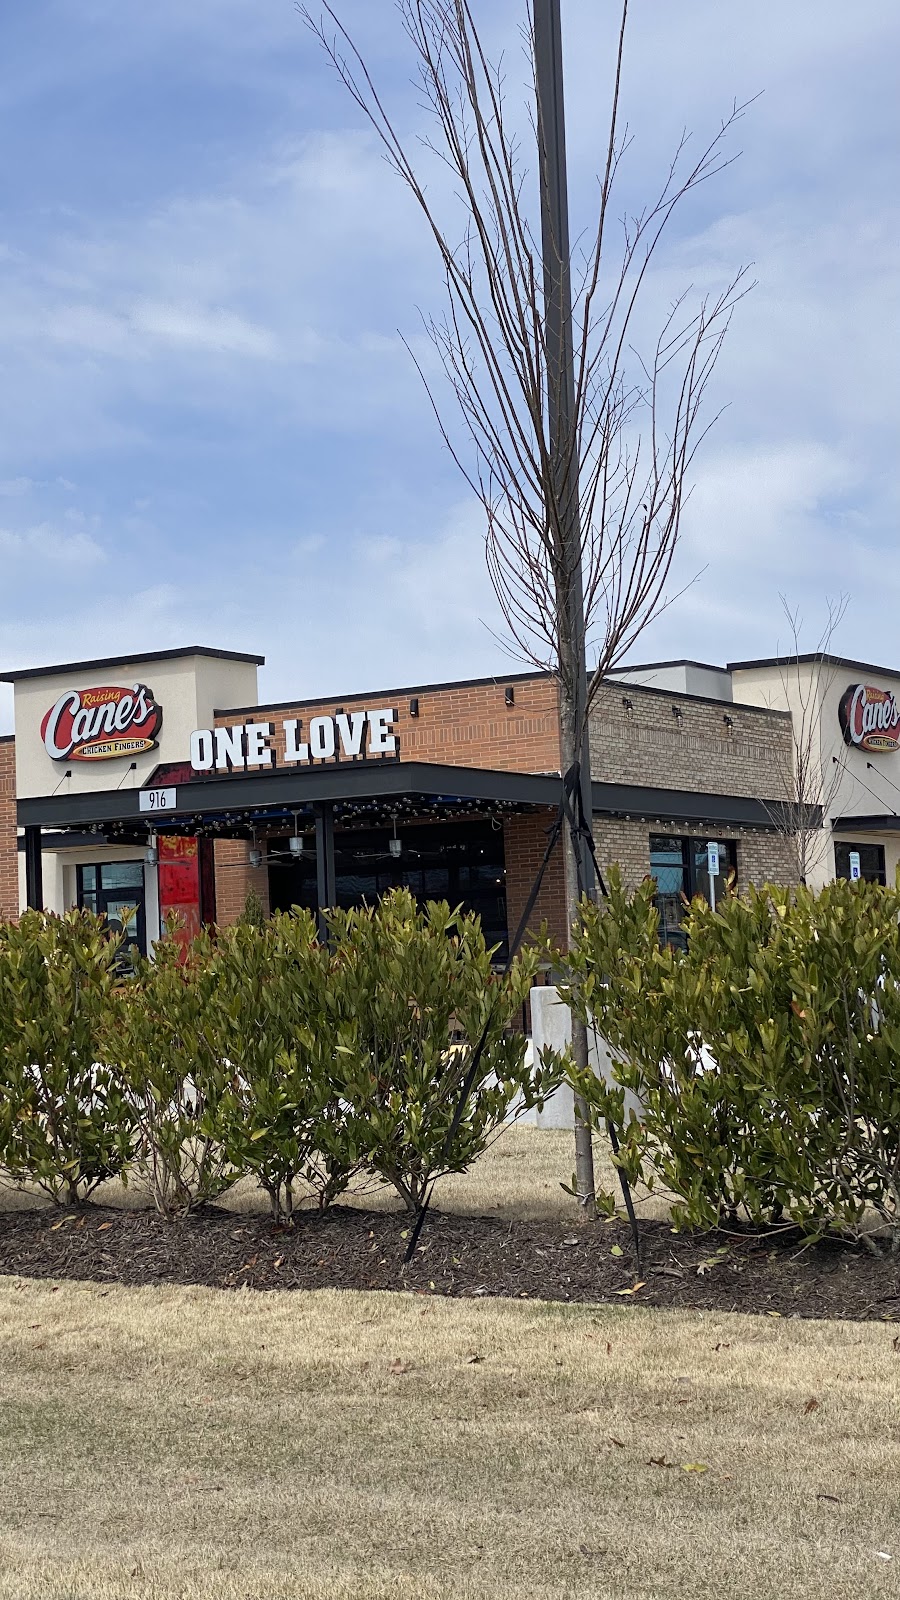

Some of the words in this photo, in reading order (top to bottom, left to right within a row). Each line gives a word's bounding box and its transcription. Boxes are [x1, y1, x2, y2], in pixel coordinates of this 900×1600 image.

[82, 690, 121, 707] Raising
[850, 684, 900, 743] Cane's
[45, 683, 154, 759] Cane's
[190, 722, 274, 771] ONE
[283, 708, 396, 762] LOVE
[82, 744, 112, 755] CHICKEN
[114, 740, 145, 751] FINGERS
[149, 791, 166, 808] 916
